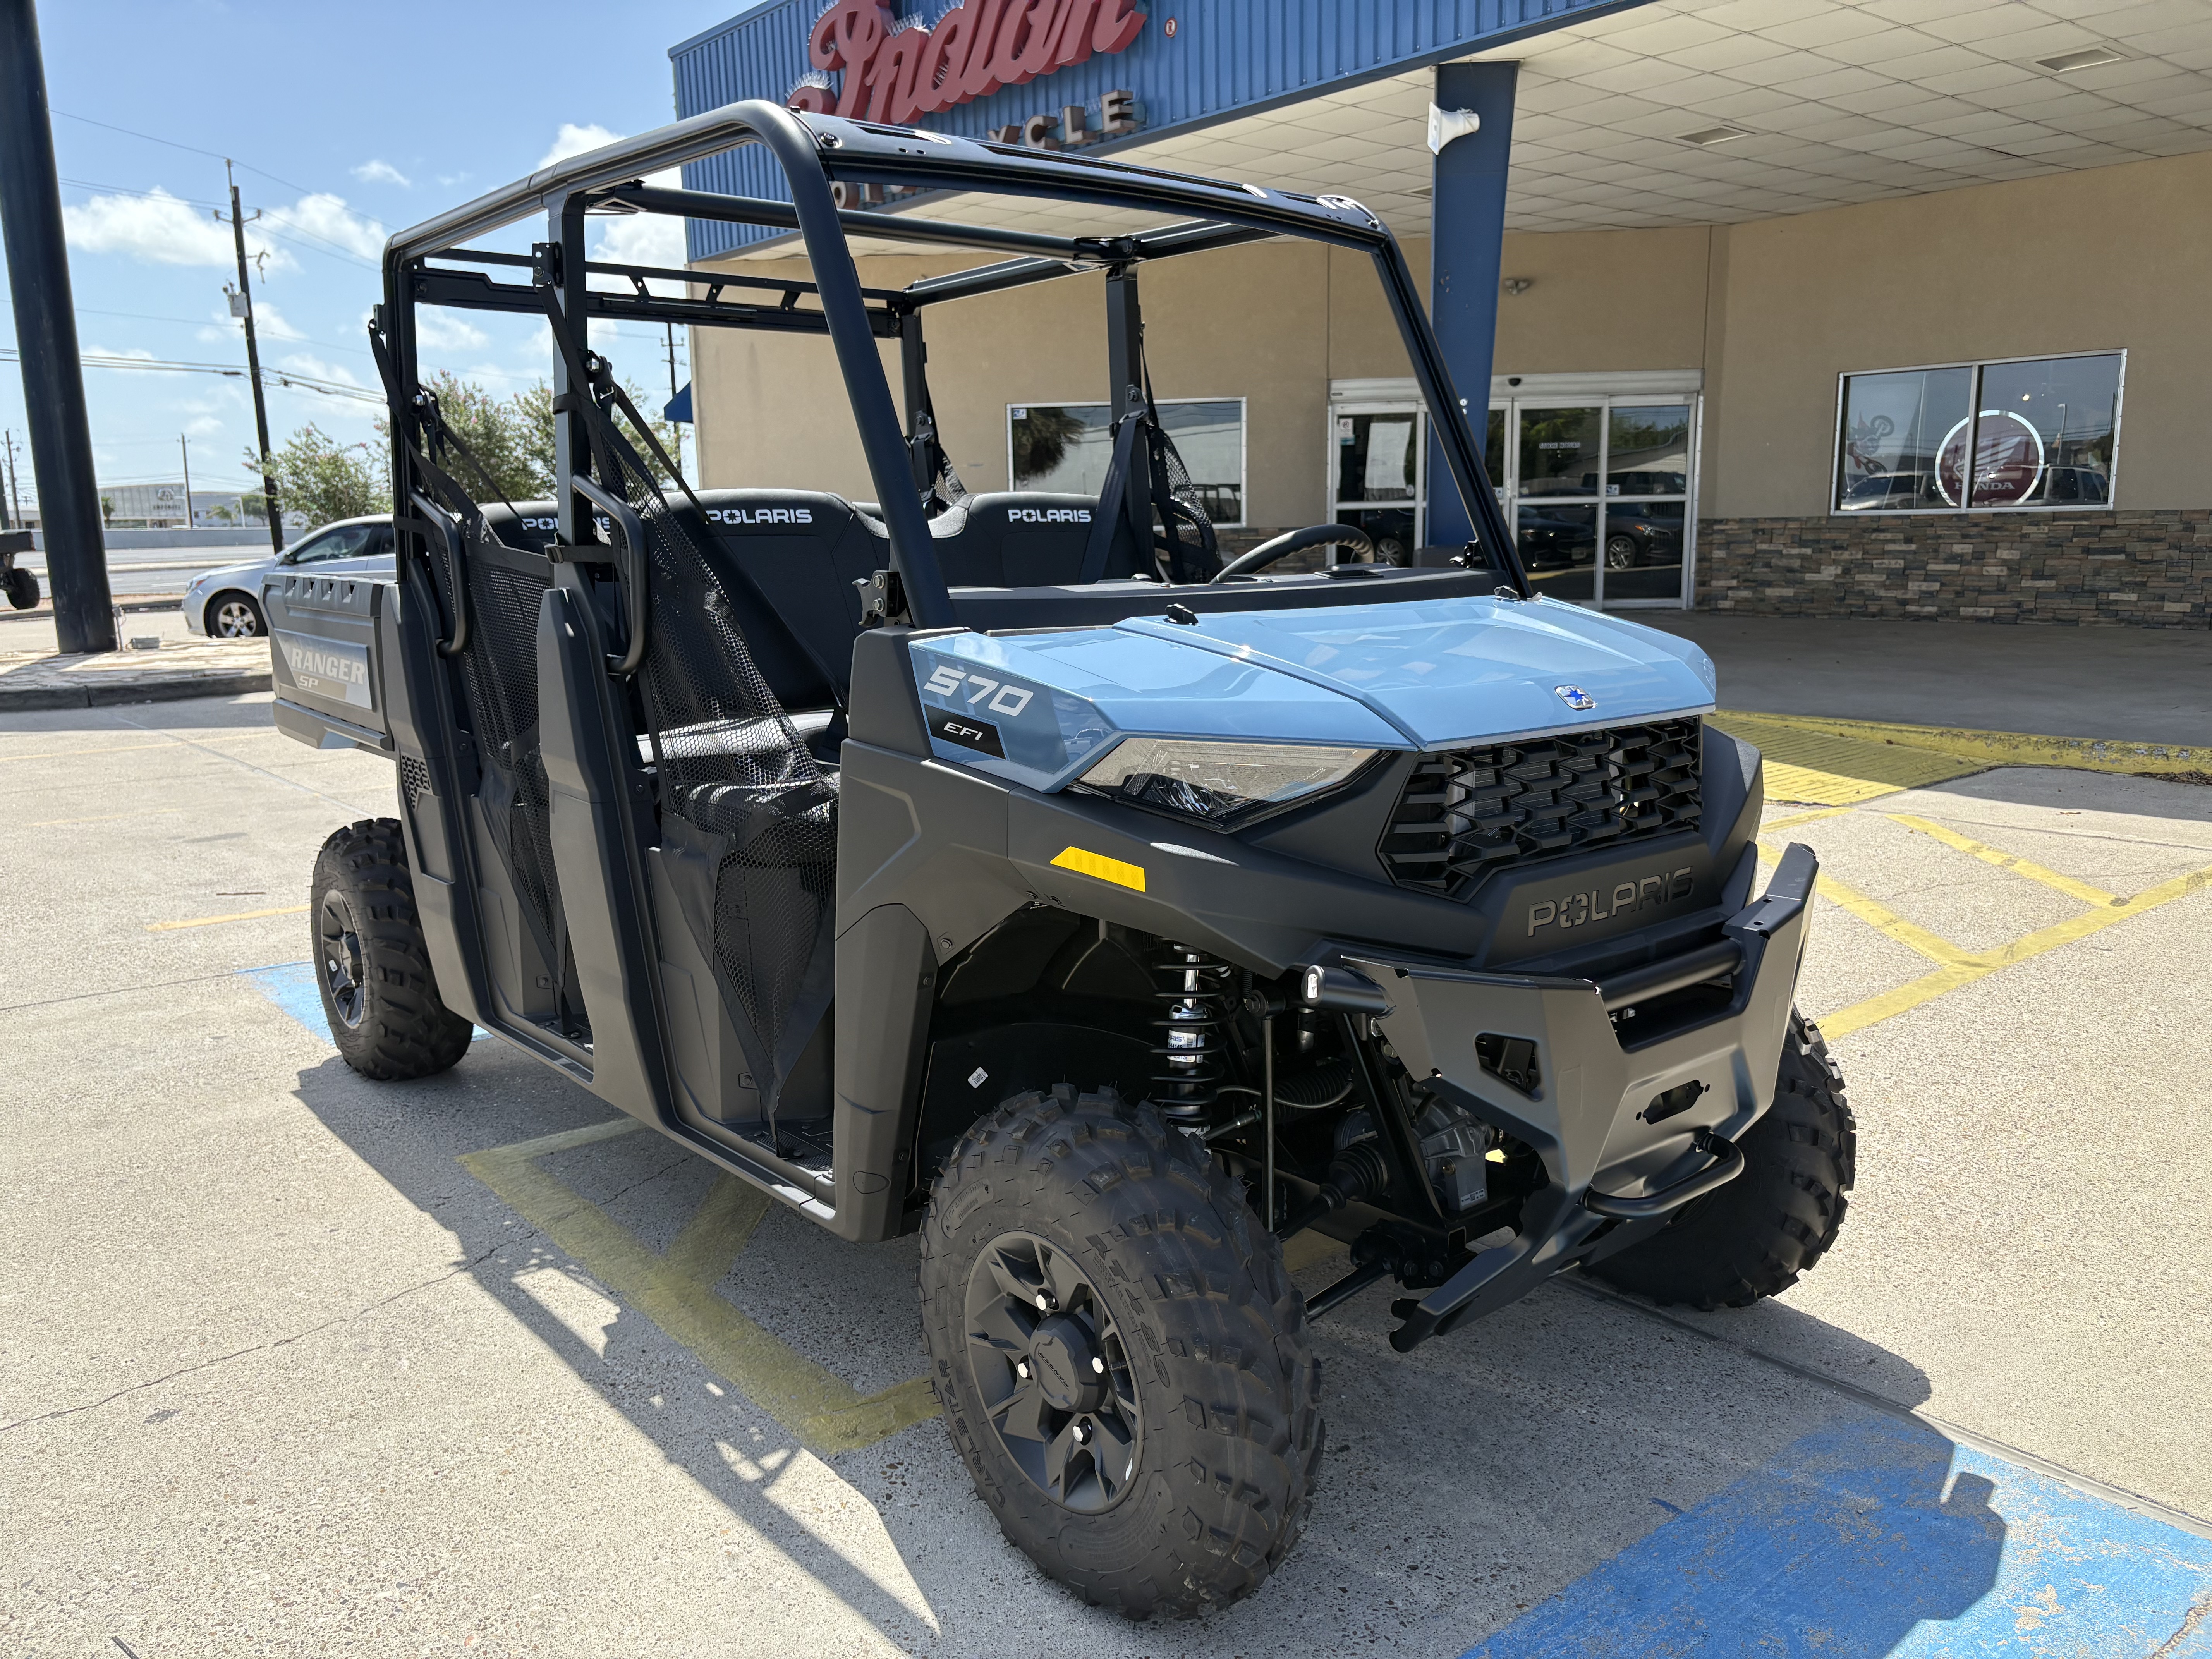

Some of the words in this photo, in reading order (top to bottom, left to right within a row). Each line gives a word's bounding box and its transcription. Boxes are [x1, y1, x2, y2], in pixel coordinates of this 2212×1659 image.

[1954, 481, 2015, 490] HNDA
[706, 509, 812, 524] POLARIS
[1008, 509, 1091, 522] POLARIS
[291, 647, 366, 685] RANGER
[299, 675, 318, 688] SP
[923, 665, 1034, 716] 570
[943, 722, 983, 740] EFI
[1528, 866, 1695, 937] POLARIS
[938, 1359, 1006, 1508] CARLSTAR
